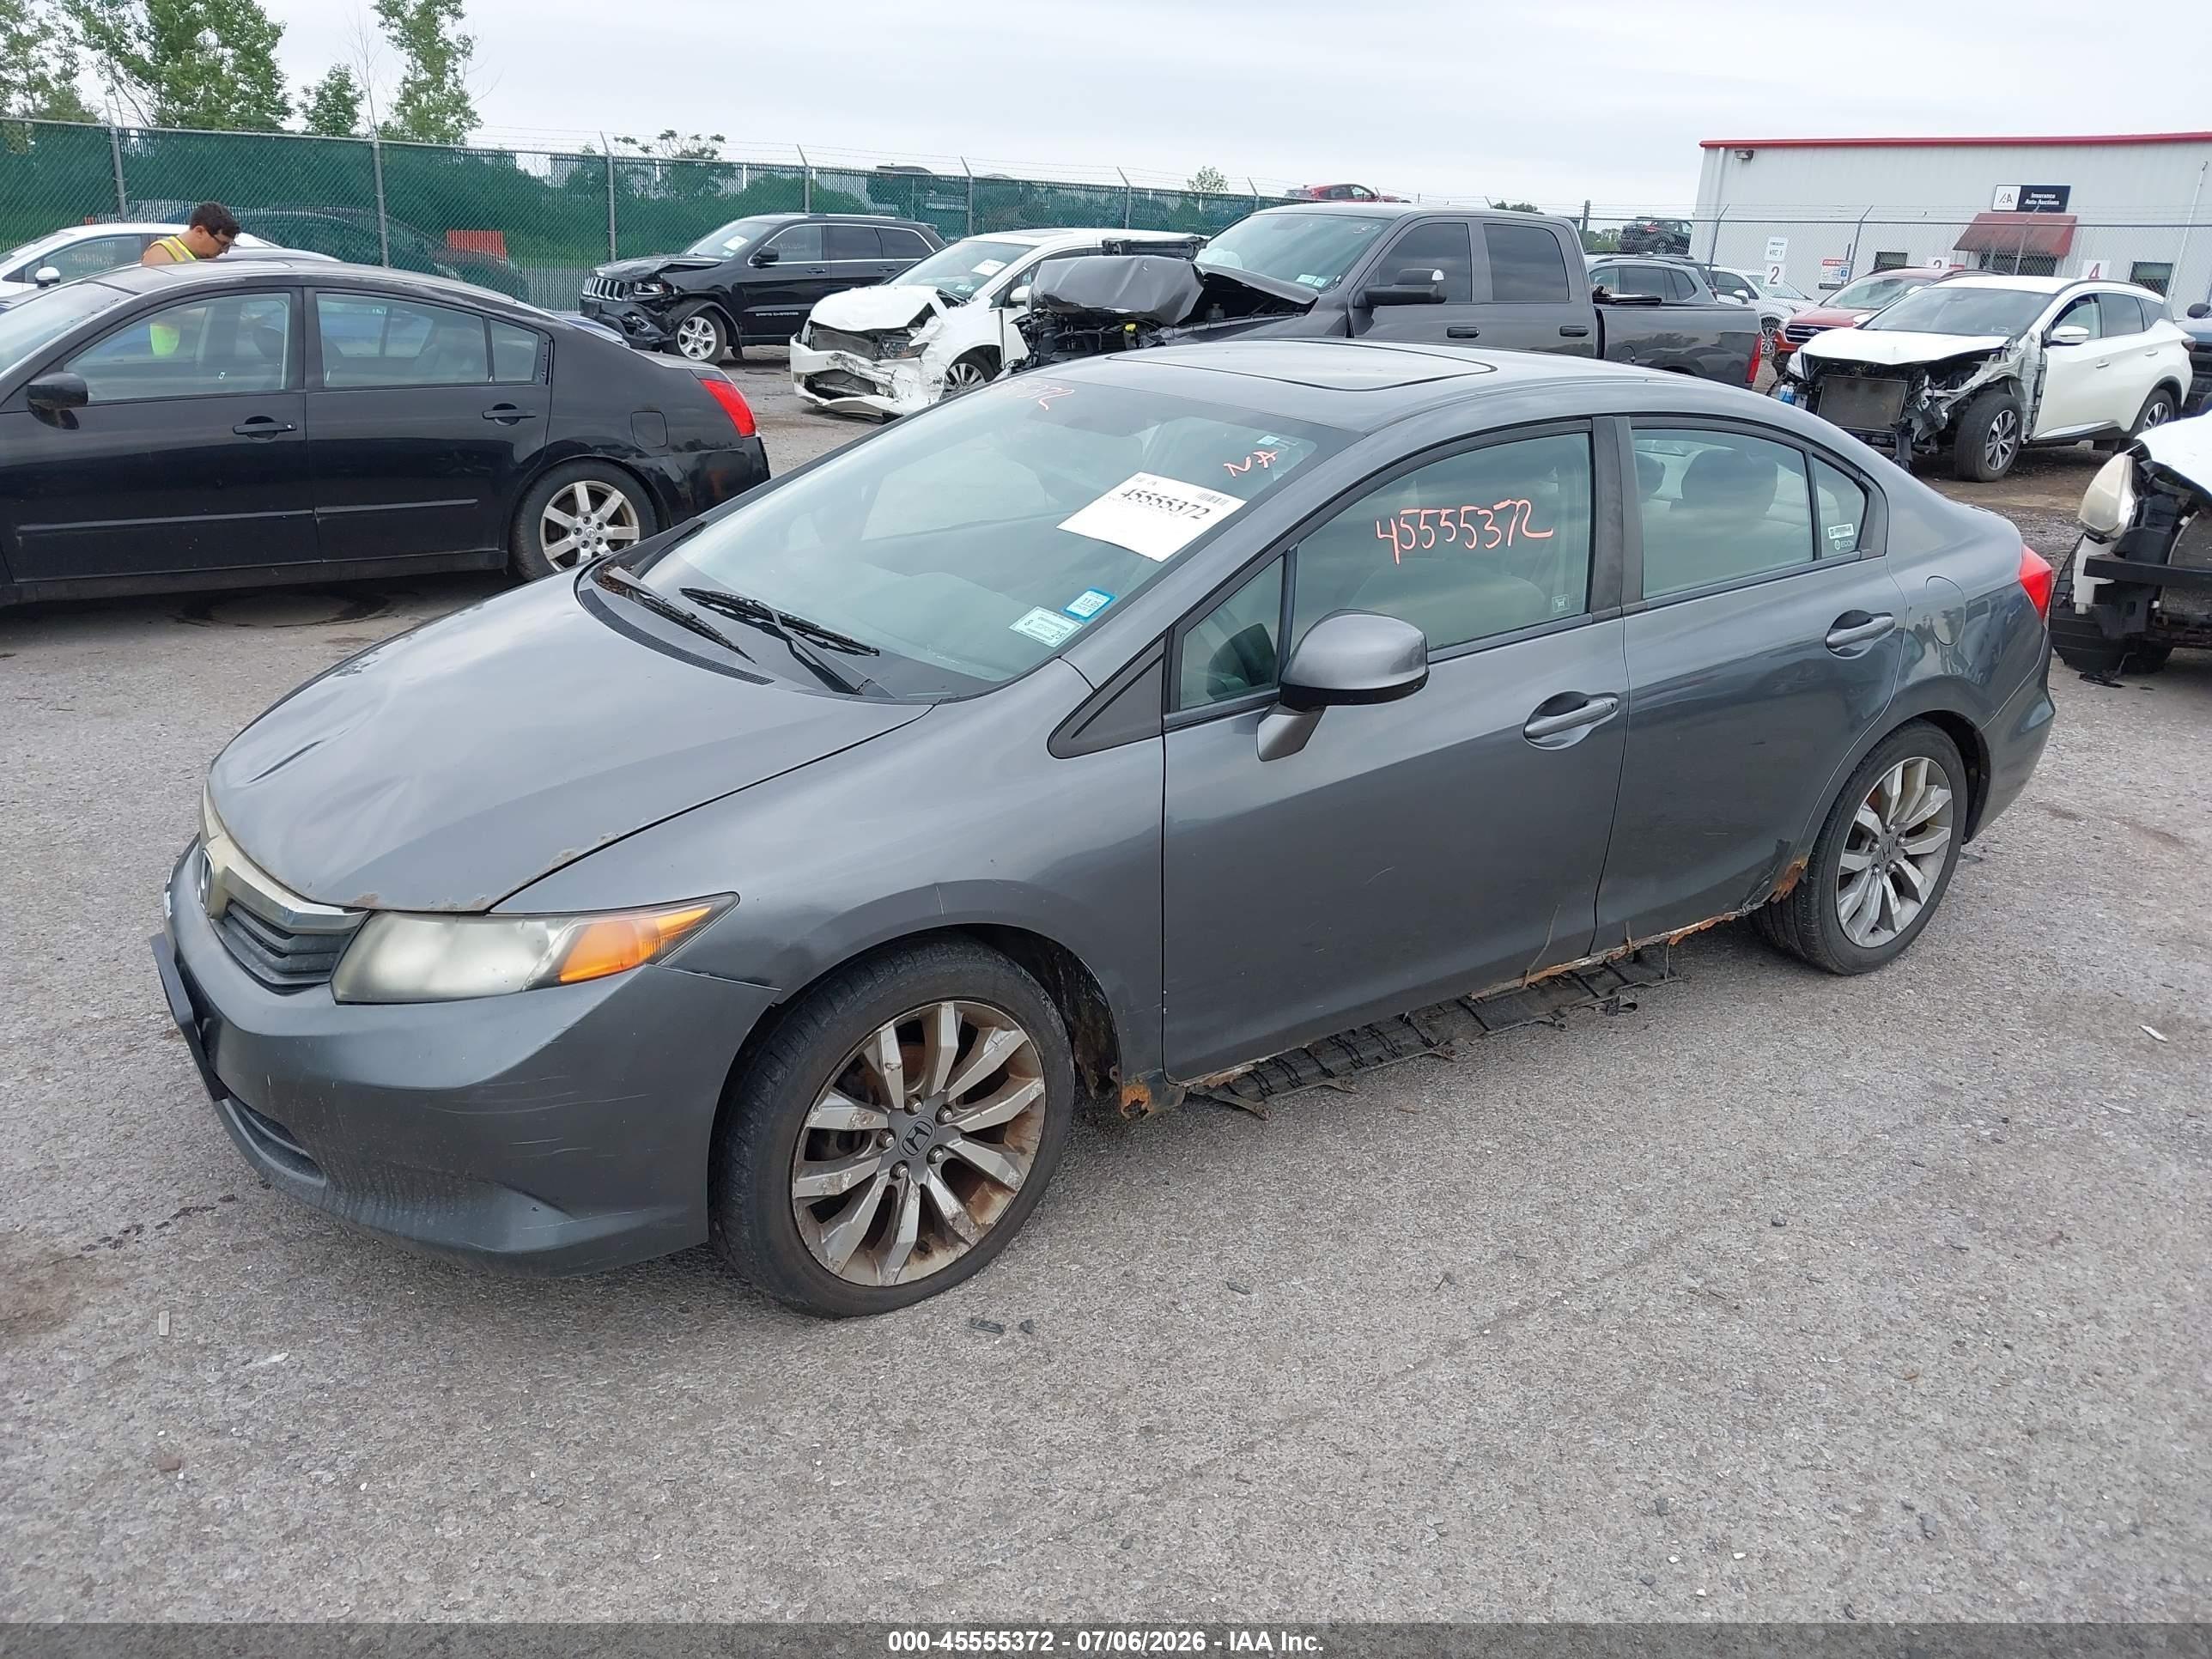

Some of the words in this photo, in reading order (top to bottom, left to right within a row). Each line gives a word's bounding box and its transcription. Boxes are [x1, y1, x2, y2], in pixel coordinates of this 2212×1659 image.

[1769, 266, 1780, 284] 2
[2087, 263, 2101, 280] 4
[1121, 488, 1211, 520] 45555372
[1374, 498, 1553, 565] 45555372
